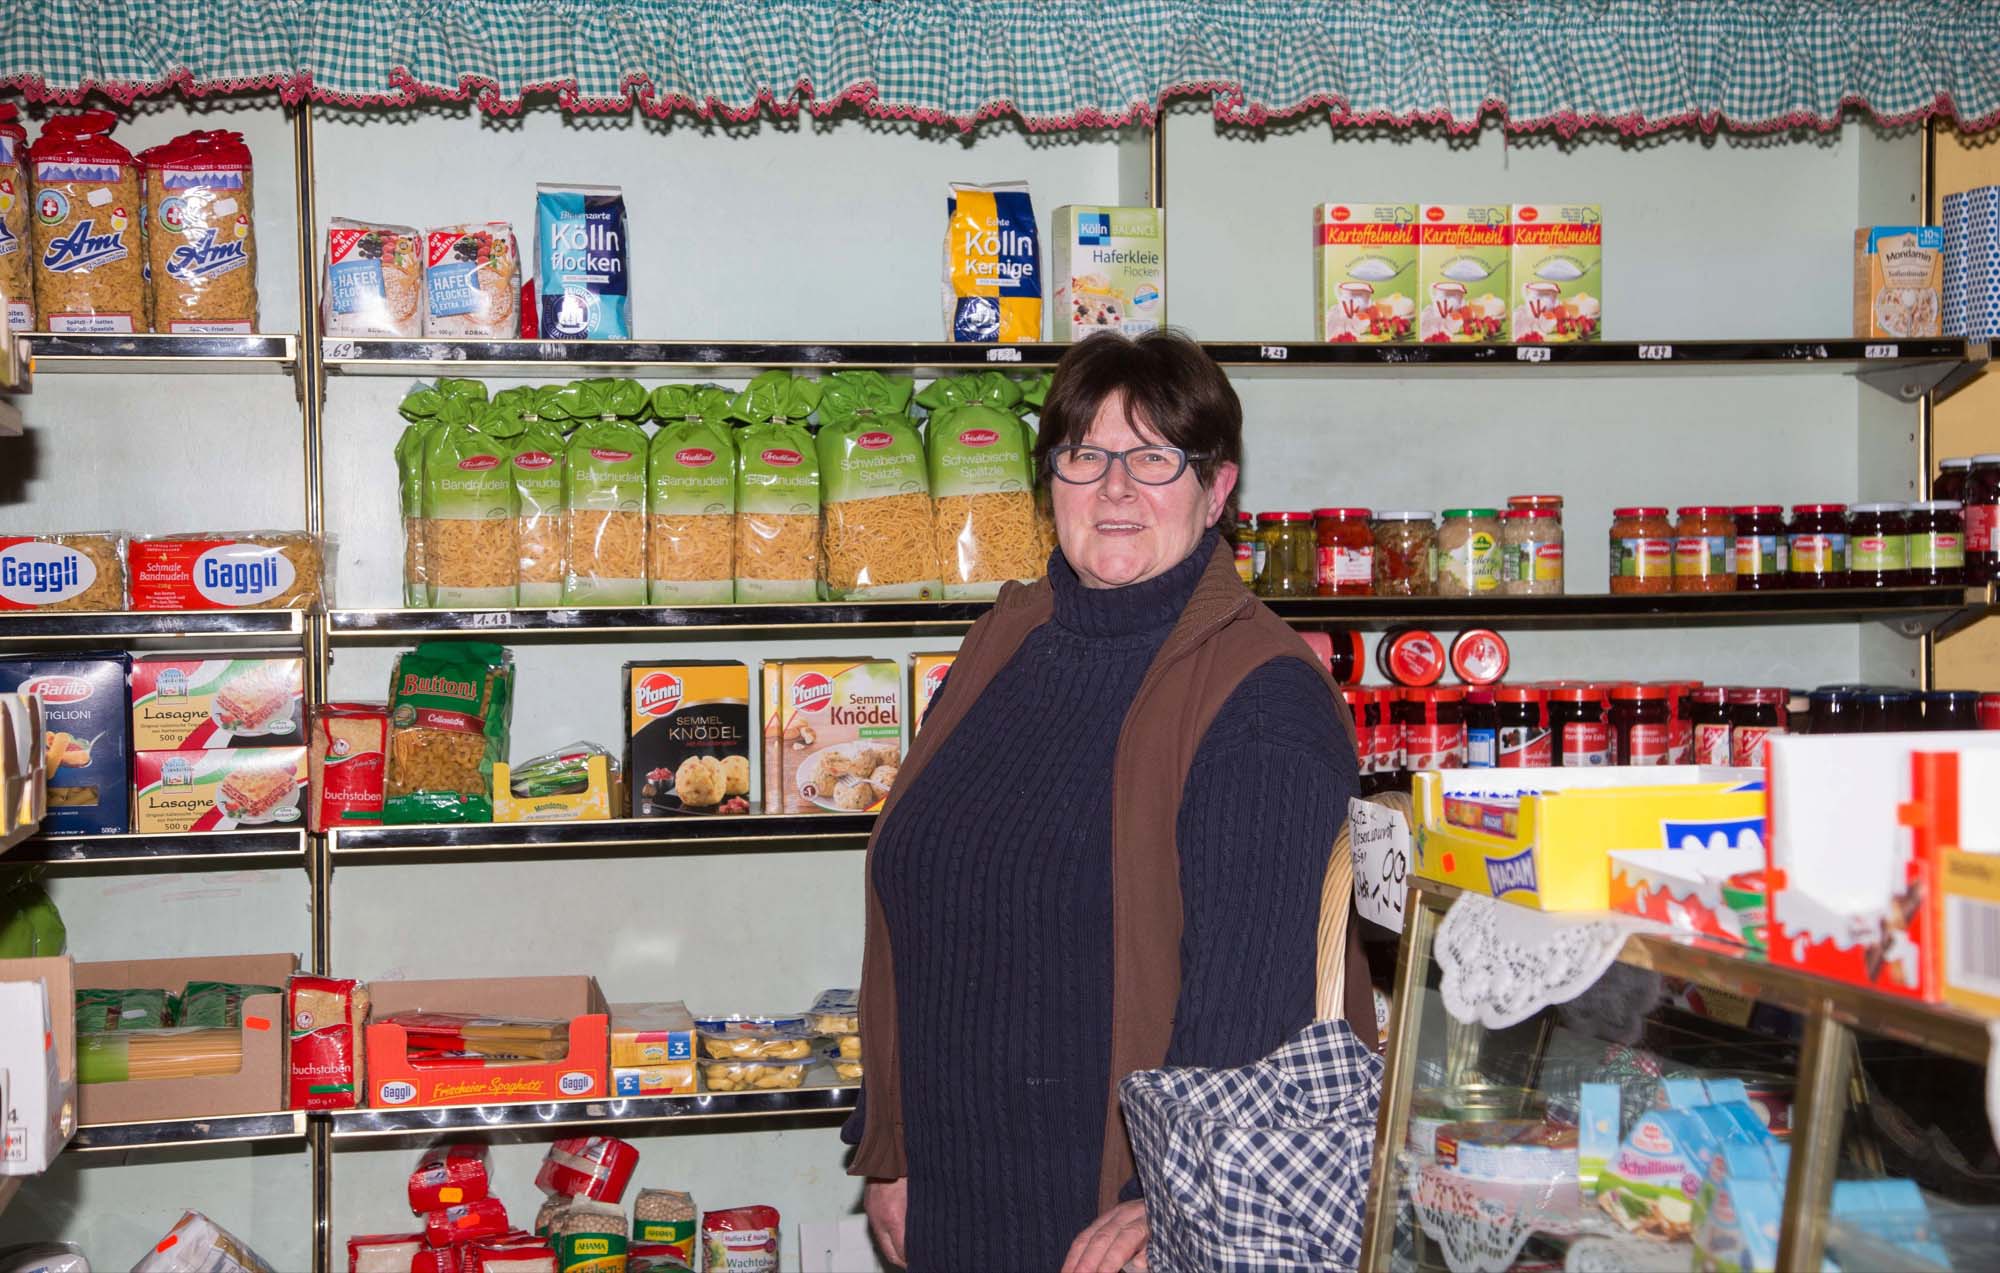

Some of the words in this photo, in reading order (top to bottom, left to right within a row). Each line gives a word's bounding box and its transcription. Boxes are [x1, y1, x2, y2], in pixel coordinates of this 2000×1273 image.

[1081, 222, 1108, 235] Kölln
[1328, 223, 1414, 245] Kartoffelmehl
[1422, 224, 1504, 245] Kartoffelmehl
[1514, 224, 1599, 244] Kartoffelmehl
[551, 223, 620, 252] Kölln
[965, 230, 1033, 257] Kölln
[551, 252, 621, 273] flocken
[1093, 249, 1159, 265] Haferkleie
[1886, 248, 1932, 263] Mondamin
[965, 259, 1034, 279] Kernige
[1123, 265, 1160, 277] Flocken
[338, 271, 378, 288] HAFER
[840, 452, 917, 472] Schwäbische
[941, 451, 1019, 467] Schwäbische
[663, 474, 729, 487] Bandnudeln
[859, 467, 904, 483] Spätzle
[960, 465, 1005, 480] Spätzle
[441, 479, 510, 491] Bandnudeln
[2, 556, 78, 592] Gaggli
[147, 562, 182, 572] Schmale
[139, 572, 190, 581] Bandnudeln
[204, 557, 278, 594] Gaggli
[36, 678, 88, 699] Barilla
[399, 673, 477, 700] Buitoni
[636, 679, 682, 706] Pfanni
[792, 678, 833, 705] Pfanni
[849, 693, 896, 706] Semmel
[45, 710, 92, 721] TIGLIONI
[143, 708, 209, 723] Lasagne
[676, 715, 723, 726] SEMMEL
[830, 706, 899, 726] Knödel
[159, 734, 176, 742] 500
[668, 725, 743, 741] KNÖDEL
[324, 789, 382, 802] buchstaben
[149, 797, 215, 811] Lasagne
[164, 823, 181, 831] 500
[674, 1042, 685, 1055] 3
[292, 1062, 352, 1076] buchstaben
[432, 1080, 485, 1098] Frischeier
[487, 1077, 545, 1097] Spaghetti
[562, 1074, 589, 1091] Gaggli
[383, 1085, 411, 1101] Gaggli
